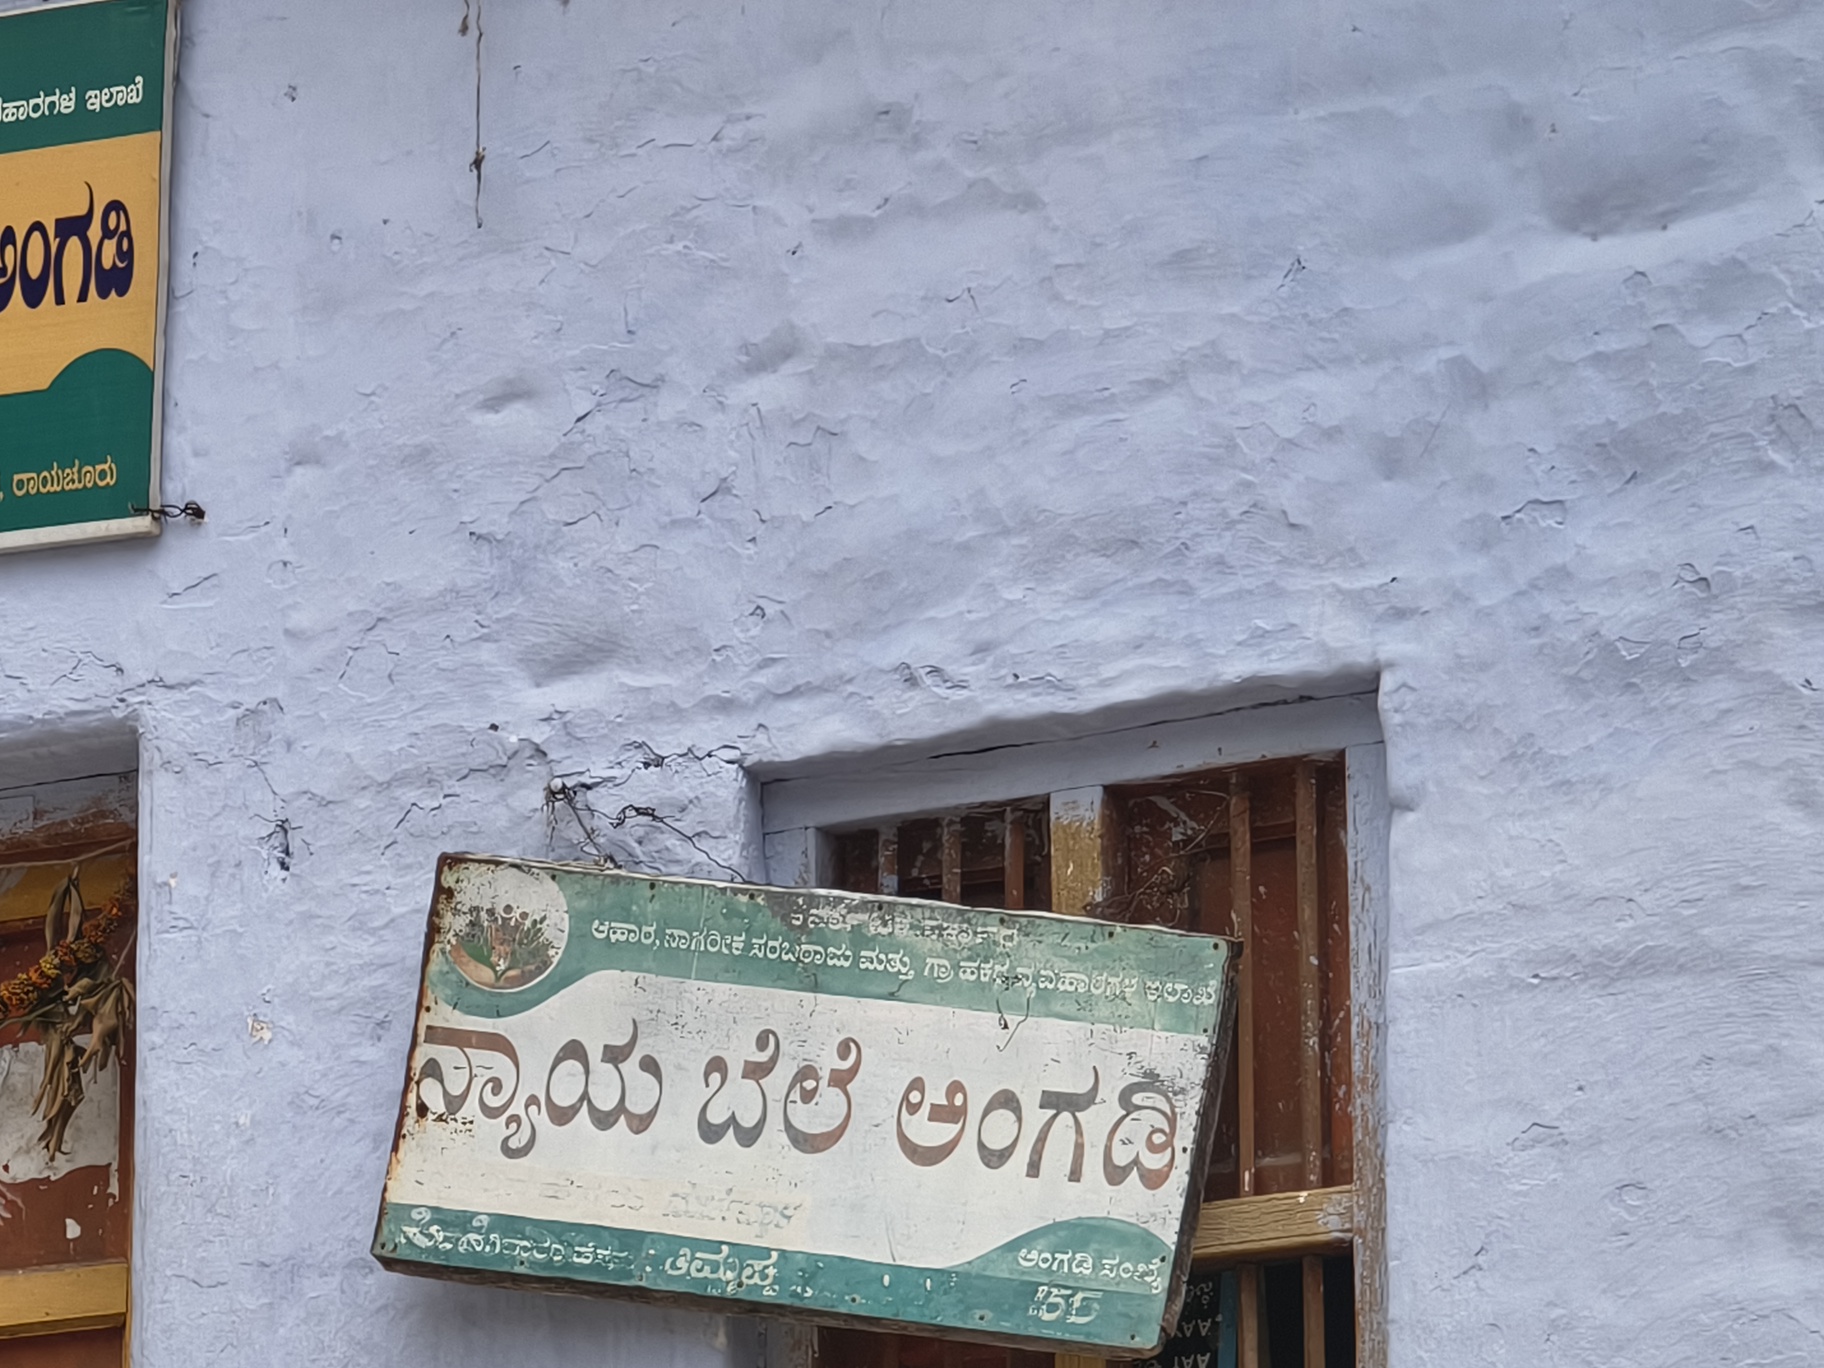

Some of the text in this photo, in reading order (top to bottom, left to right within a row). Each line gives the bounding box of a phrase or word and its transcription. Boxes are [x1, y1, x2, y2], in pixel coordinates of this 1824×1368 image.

[85, 75, 143, 112] ಇಲಾಖೆ
[12, 455, 116, 496] ರಾಯಚೂರು
[859, 945, 915, 980] ಮತ್ತು
[417, 1018, 1177, 1191] ನ್ಯಾಯ ಬೆಲೆ ಅಂಗಡಿ
[1017, 1243, 1163, 1295] ಅಂಗಡಿ ಸಂಖ್ಯೆ
